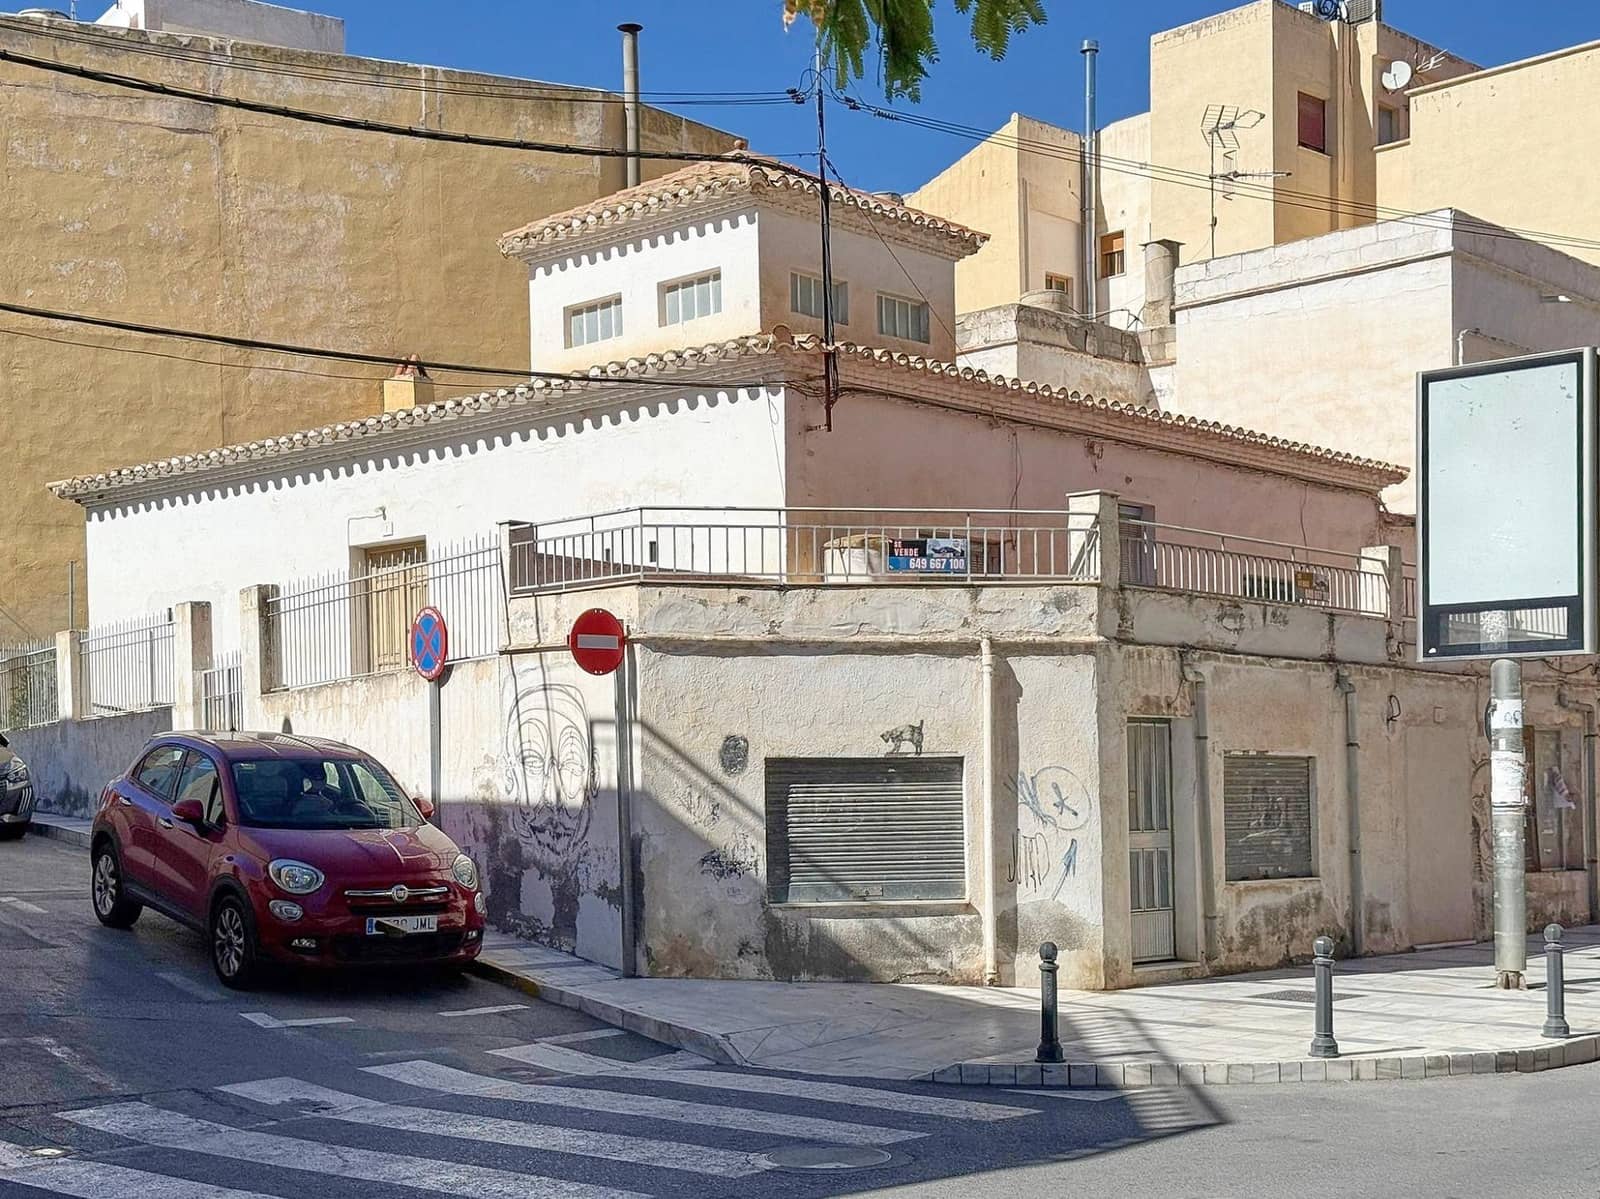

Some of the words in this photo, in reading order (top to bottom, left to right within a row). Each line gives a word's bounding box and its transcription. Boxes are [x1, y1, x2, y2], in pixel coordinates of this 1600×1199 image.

[894, 540, 902, 548] SE
[894, 548, 919, 556] VENDE
[909, 558, 927, 569] 649
[929, 558, 947, 569] 667
[949, 558, 965, 569] 100
[413, 917, 434, 929] JML
